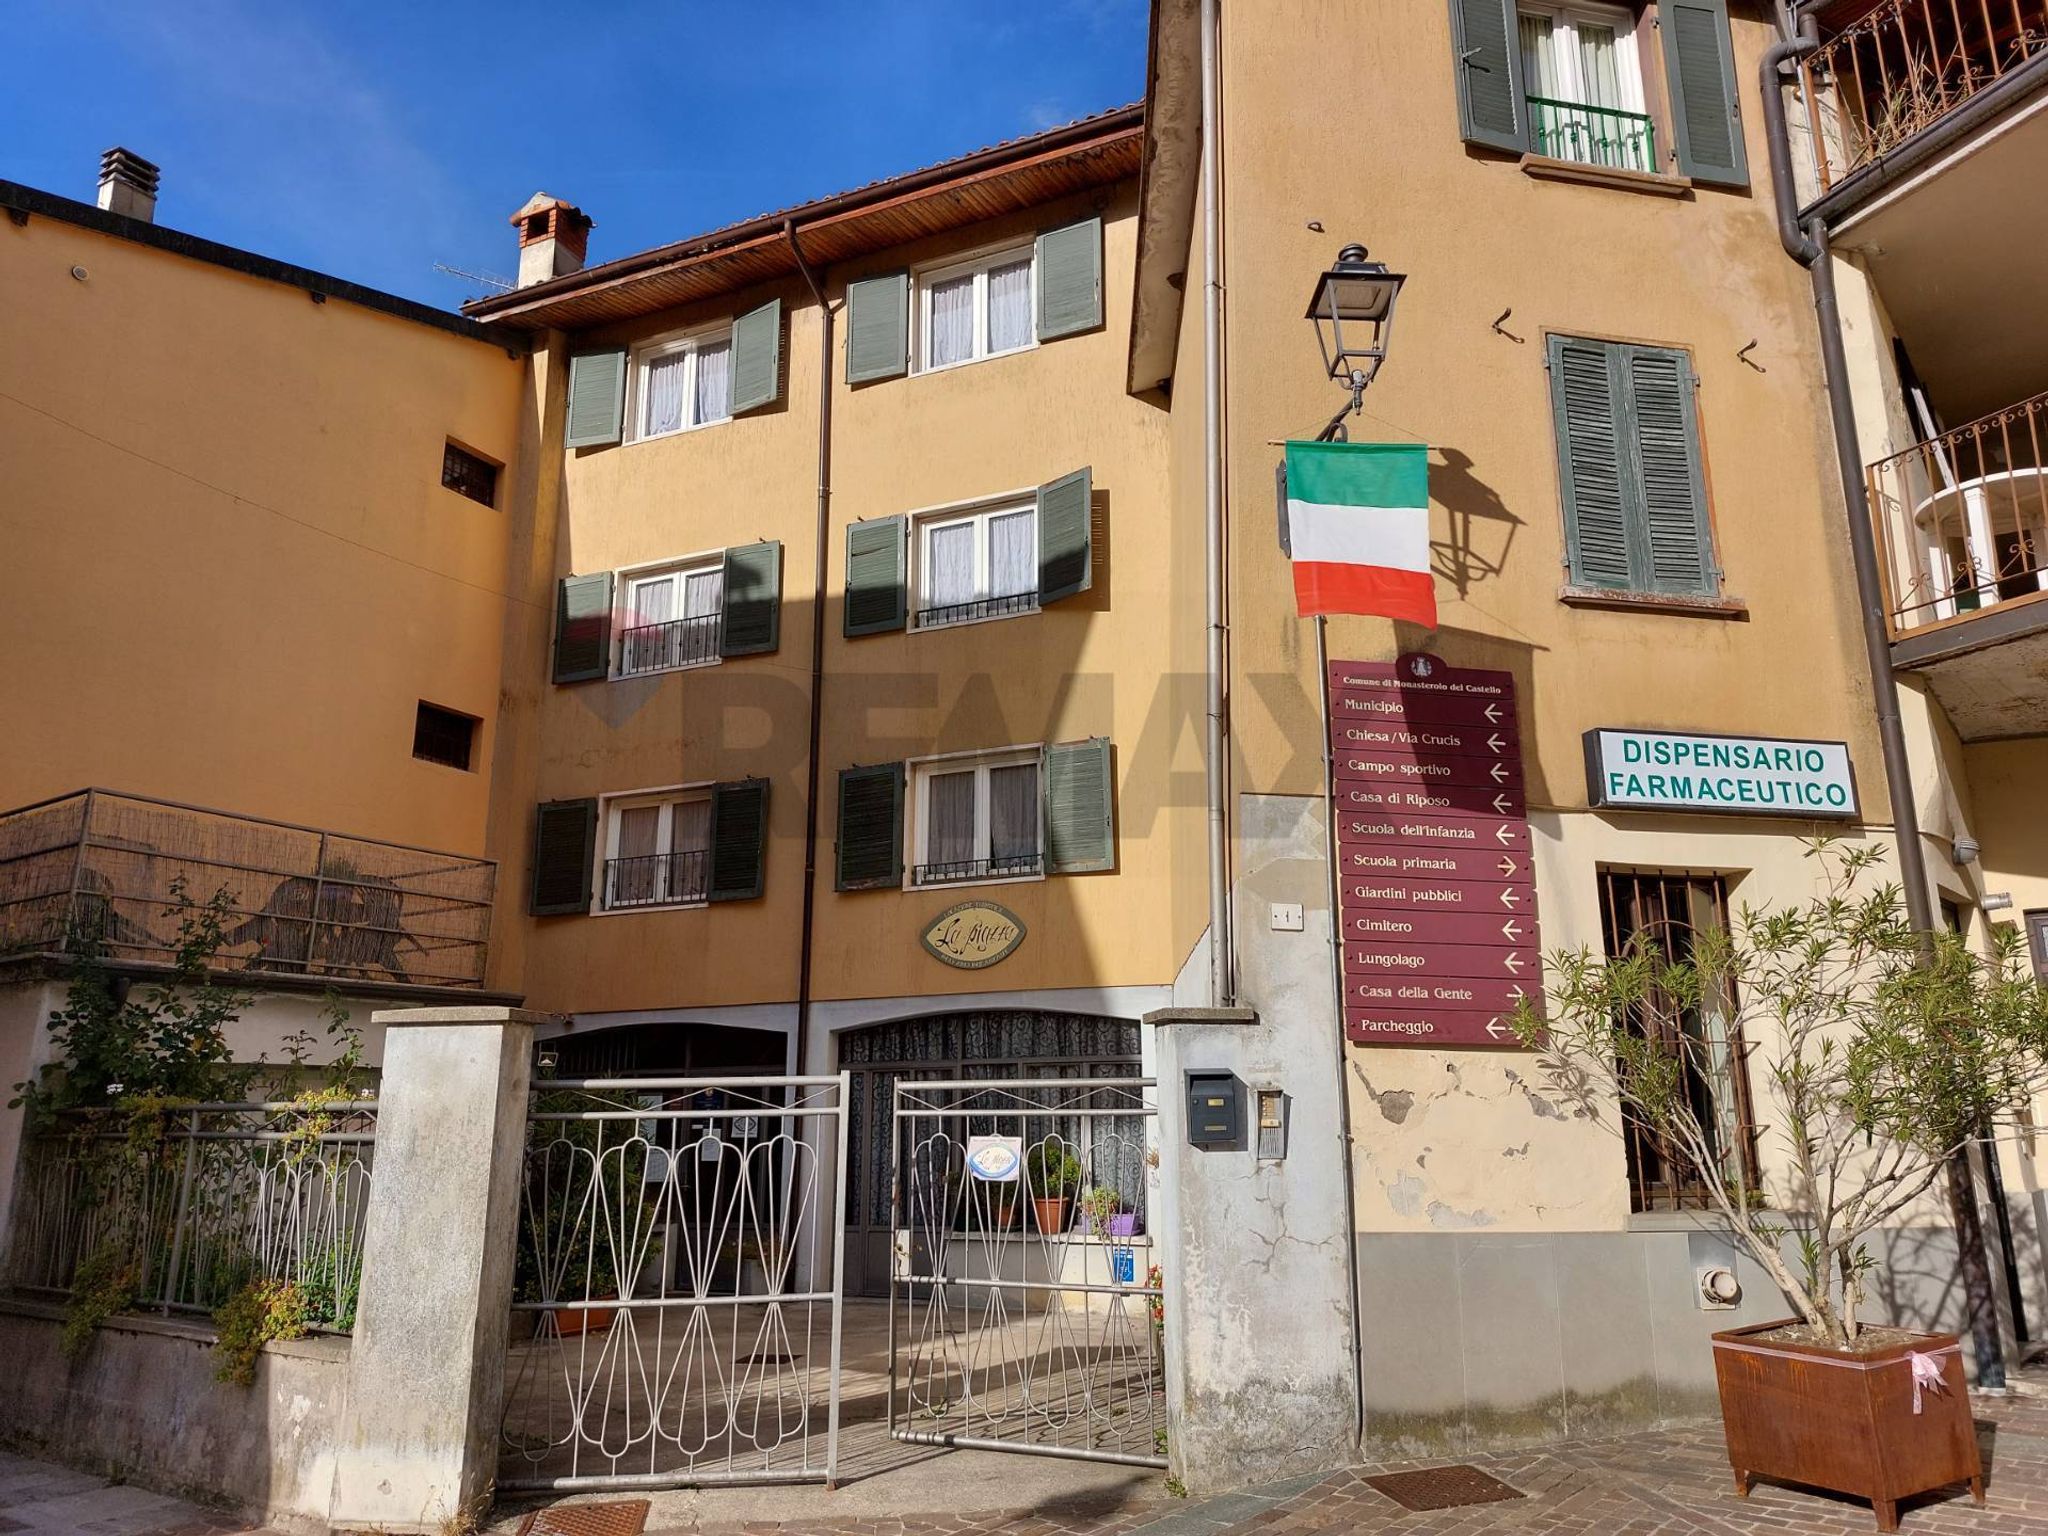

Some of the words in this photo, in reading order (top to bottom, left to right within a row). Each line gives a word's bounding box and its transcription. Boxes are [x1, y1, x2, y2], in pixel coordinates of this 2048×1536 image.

[1343, 676, 1380, 686] Comune
[1382, 678, 1392, 687] di
[1394, 679, 1448, 690] Monasterolo
[1450, 684, 1463, 692] del
[1466, 684, 1501, 694] Castello
[1345, 699, 1404, 714] Municipio
[1347, 729, 1389, 742] Chiesa
[1421, 734, 1461, 746] Crucis
[1623, 739, 1824, 772] DISPENSARIO
[1349, 760, 1394, 774] Campo
[1400, 764, 1450, 776] sportivo
[1609, 772, 1847, 806] FARMACEUTICO
[1350, 792, 1382, 803] Casa
[1388, 793, 1400, 804] di
[1406, 793, 1450, 807] Riposo
[1352, 823, 1394, 835] Scuola
[1354, 854, 1396, 866] Scuola
[1403, 857, 1456, 870] primaria
[1355, 887, 1406, 899] Giardini
[1413, 888, 1461, 902] pubblici
[1357, 919, 1412, 932] Cimitero
[1358, 953, 1425, 968] Lungolago
[1360, 986, 1392, 998] Casa
[1398, 987, 1429, 998] della
[1434, 988, 1472, 1000] Gente
[1362, 1020, 1433, 1034] Parcheggio
